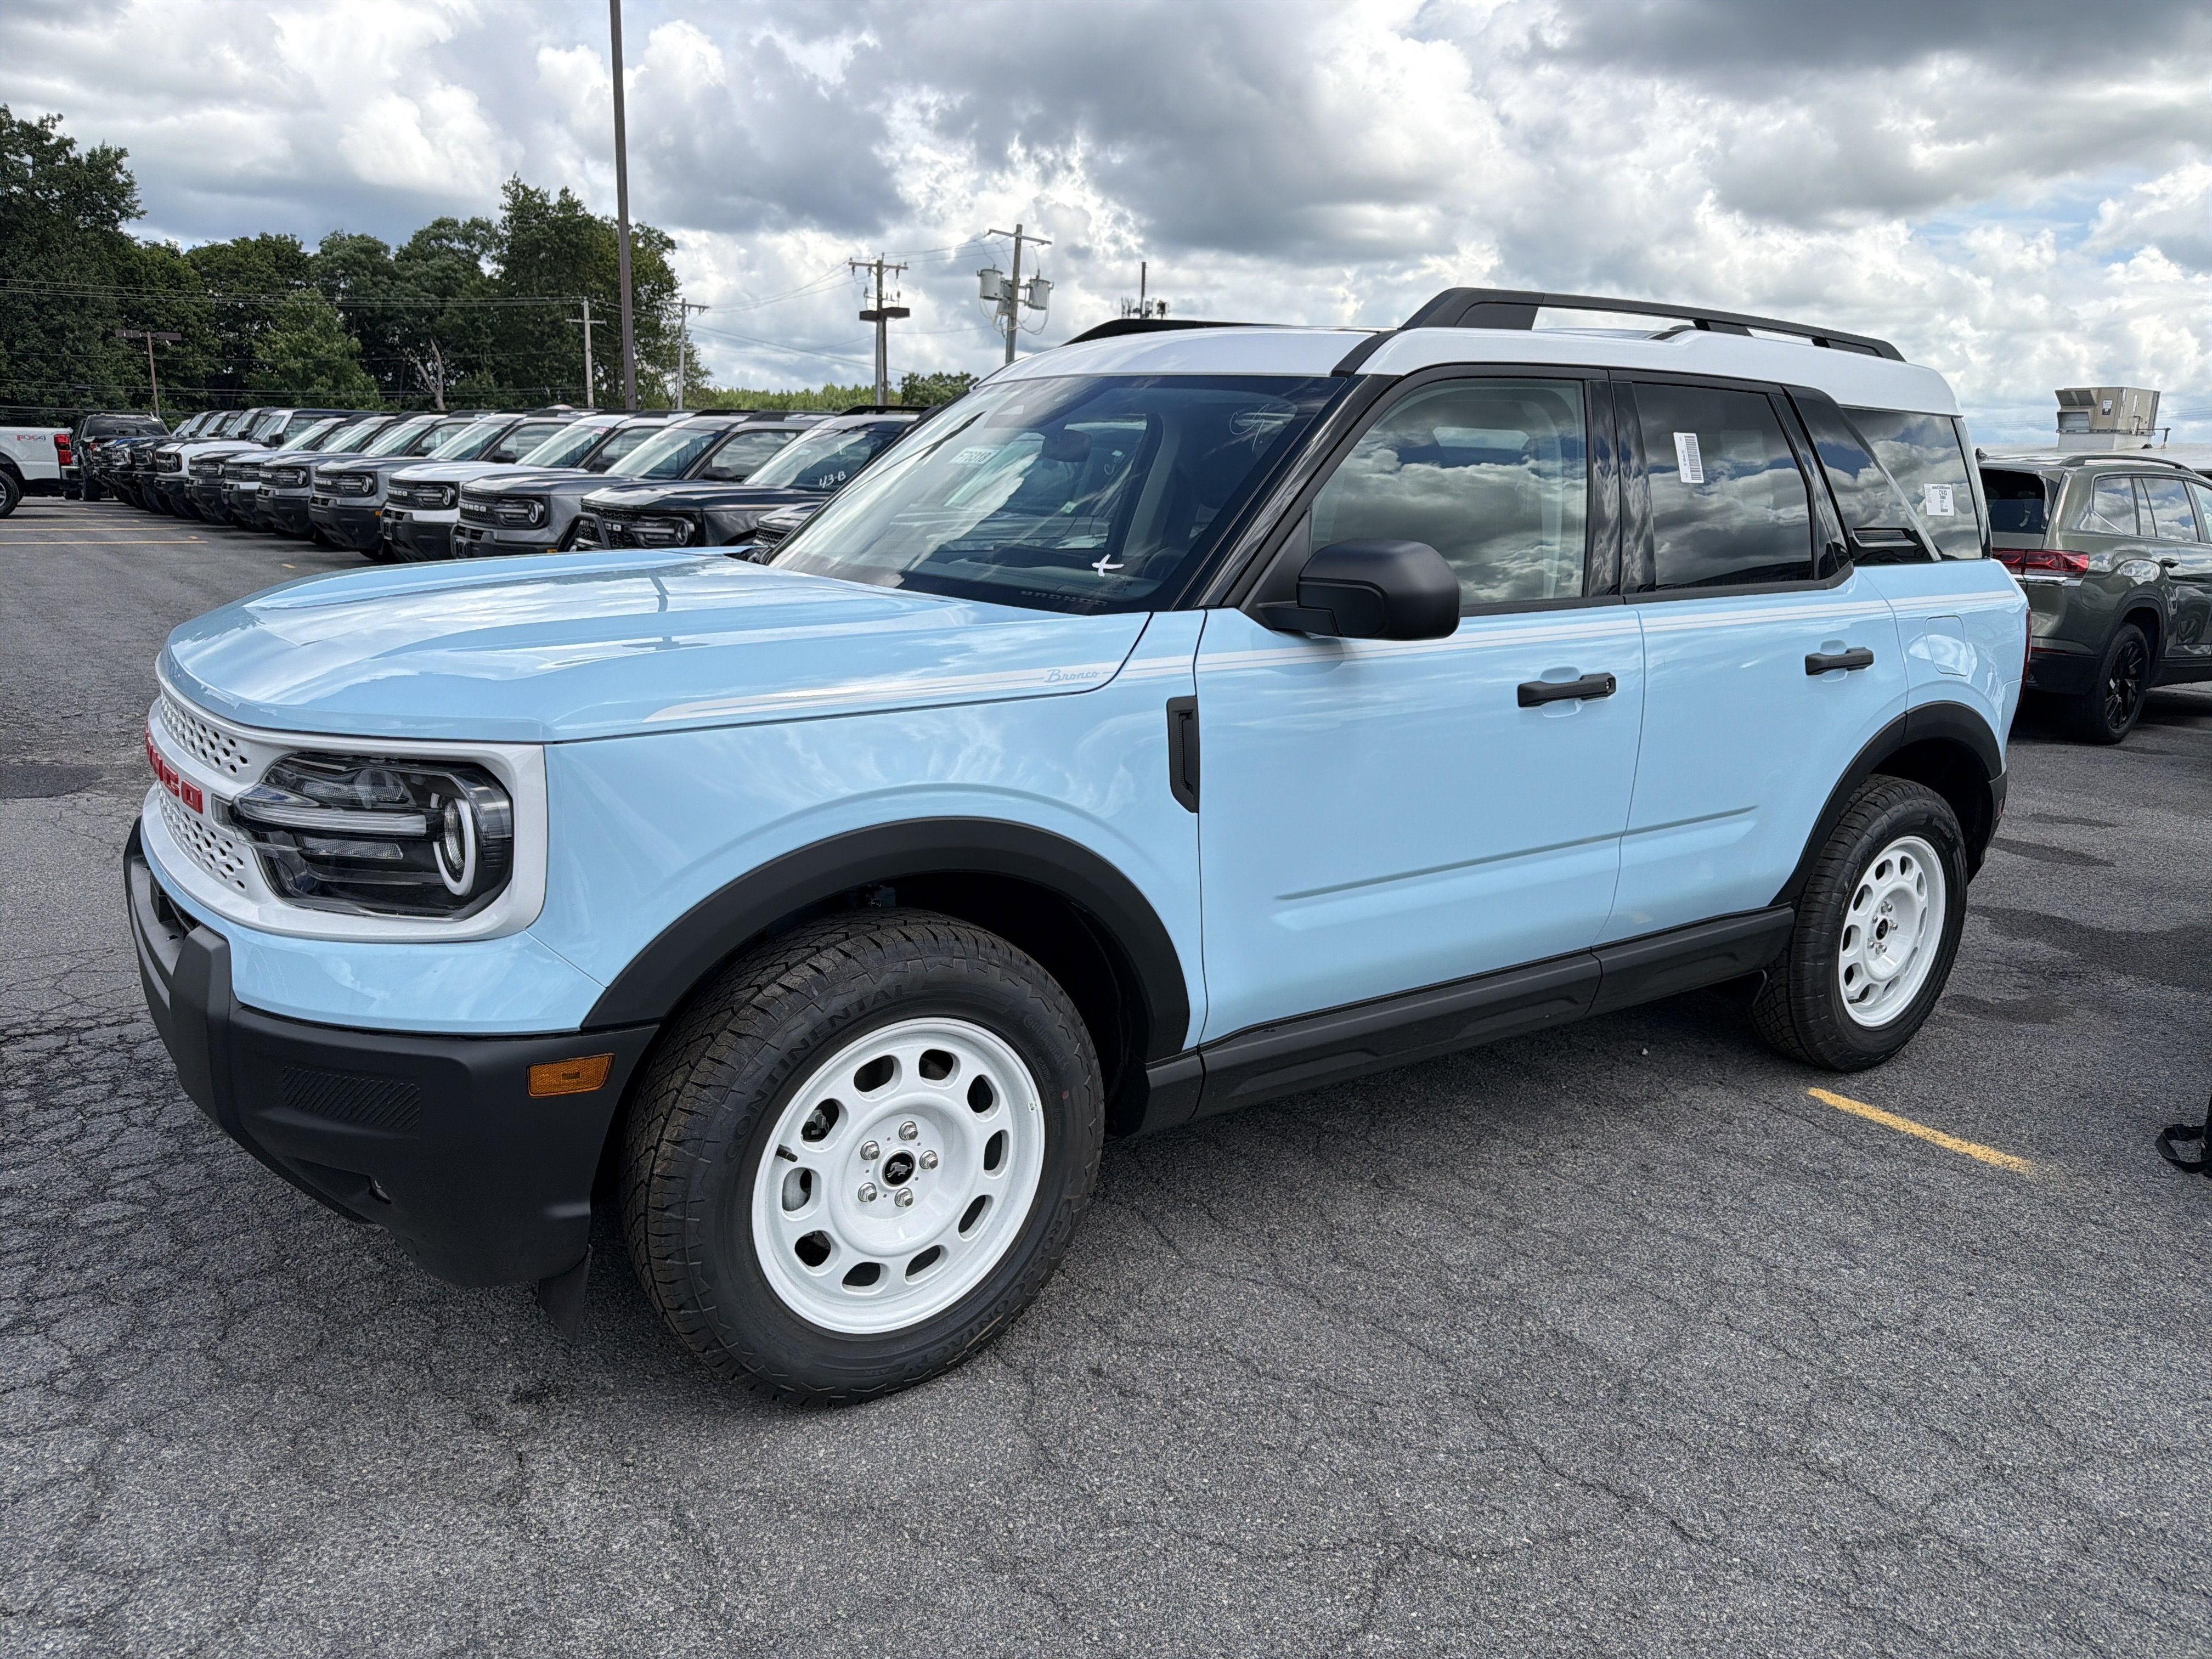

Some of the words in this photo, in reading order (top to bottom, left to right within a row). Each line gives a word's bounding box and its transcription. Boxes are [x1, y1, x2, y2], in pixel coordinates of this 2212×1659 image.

[819, 471, 847, 489] 43-B
[1044, 669, 1100, 682] Bronco
[725, 984, 913, 1164] CONTINENTAL
